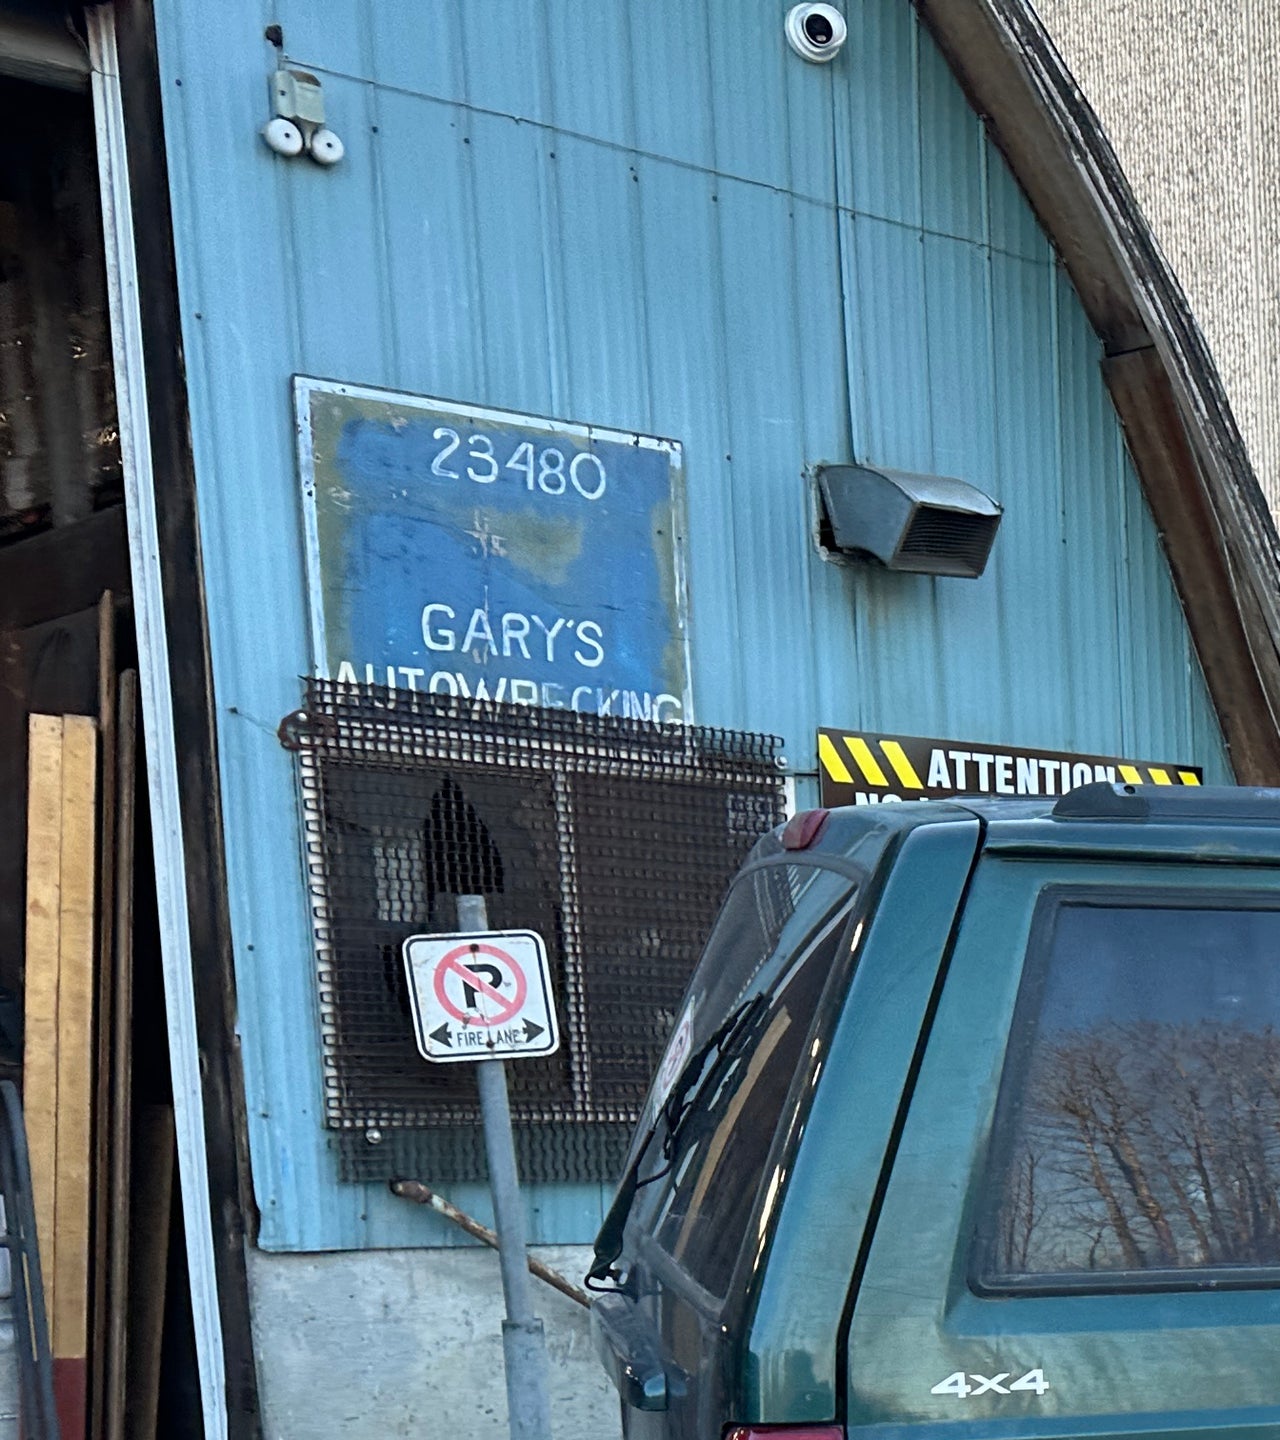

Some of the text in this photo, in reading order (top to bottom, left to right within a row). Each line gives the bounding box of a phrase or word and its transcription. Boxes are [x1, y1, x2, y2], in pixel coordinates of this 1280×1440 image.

[430, 427, 607, 500] 23480
[421, 603, 605, 668] GARY'S
[927, 749, 1116, 796] ATTENTION
[457, 1029, 523, 1047] FIRE LANE
